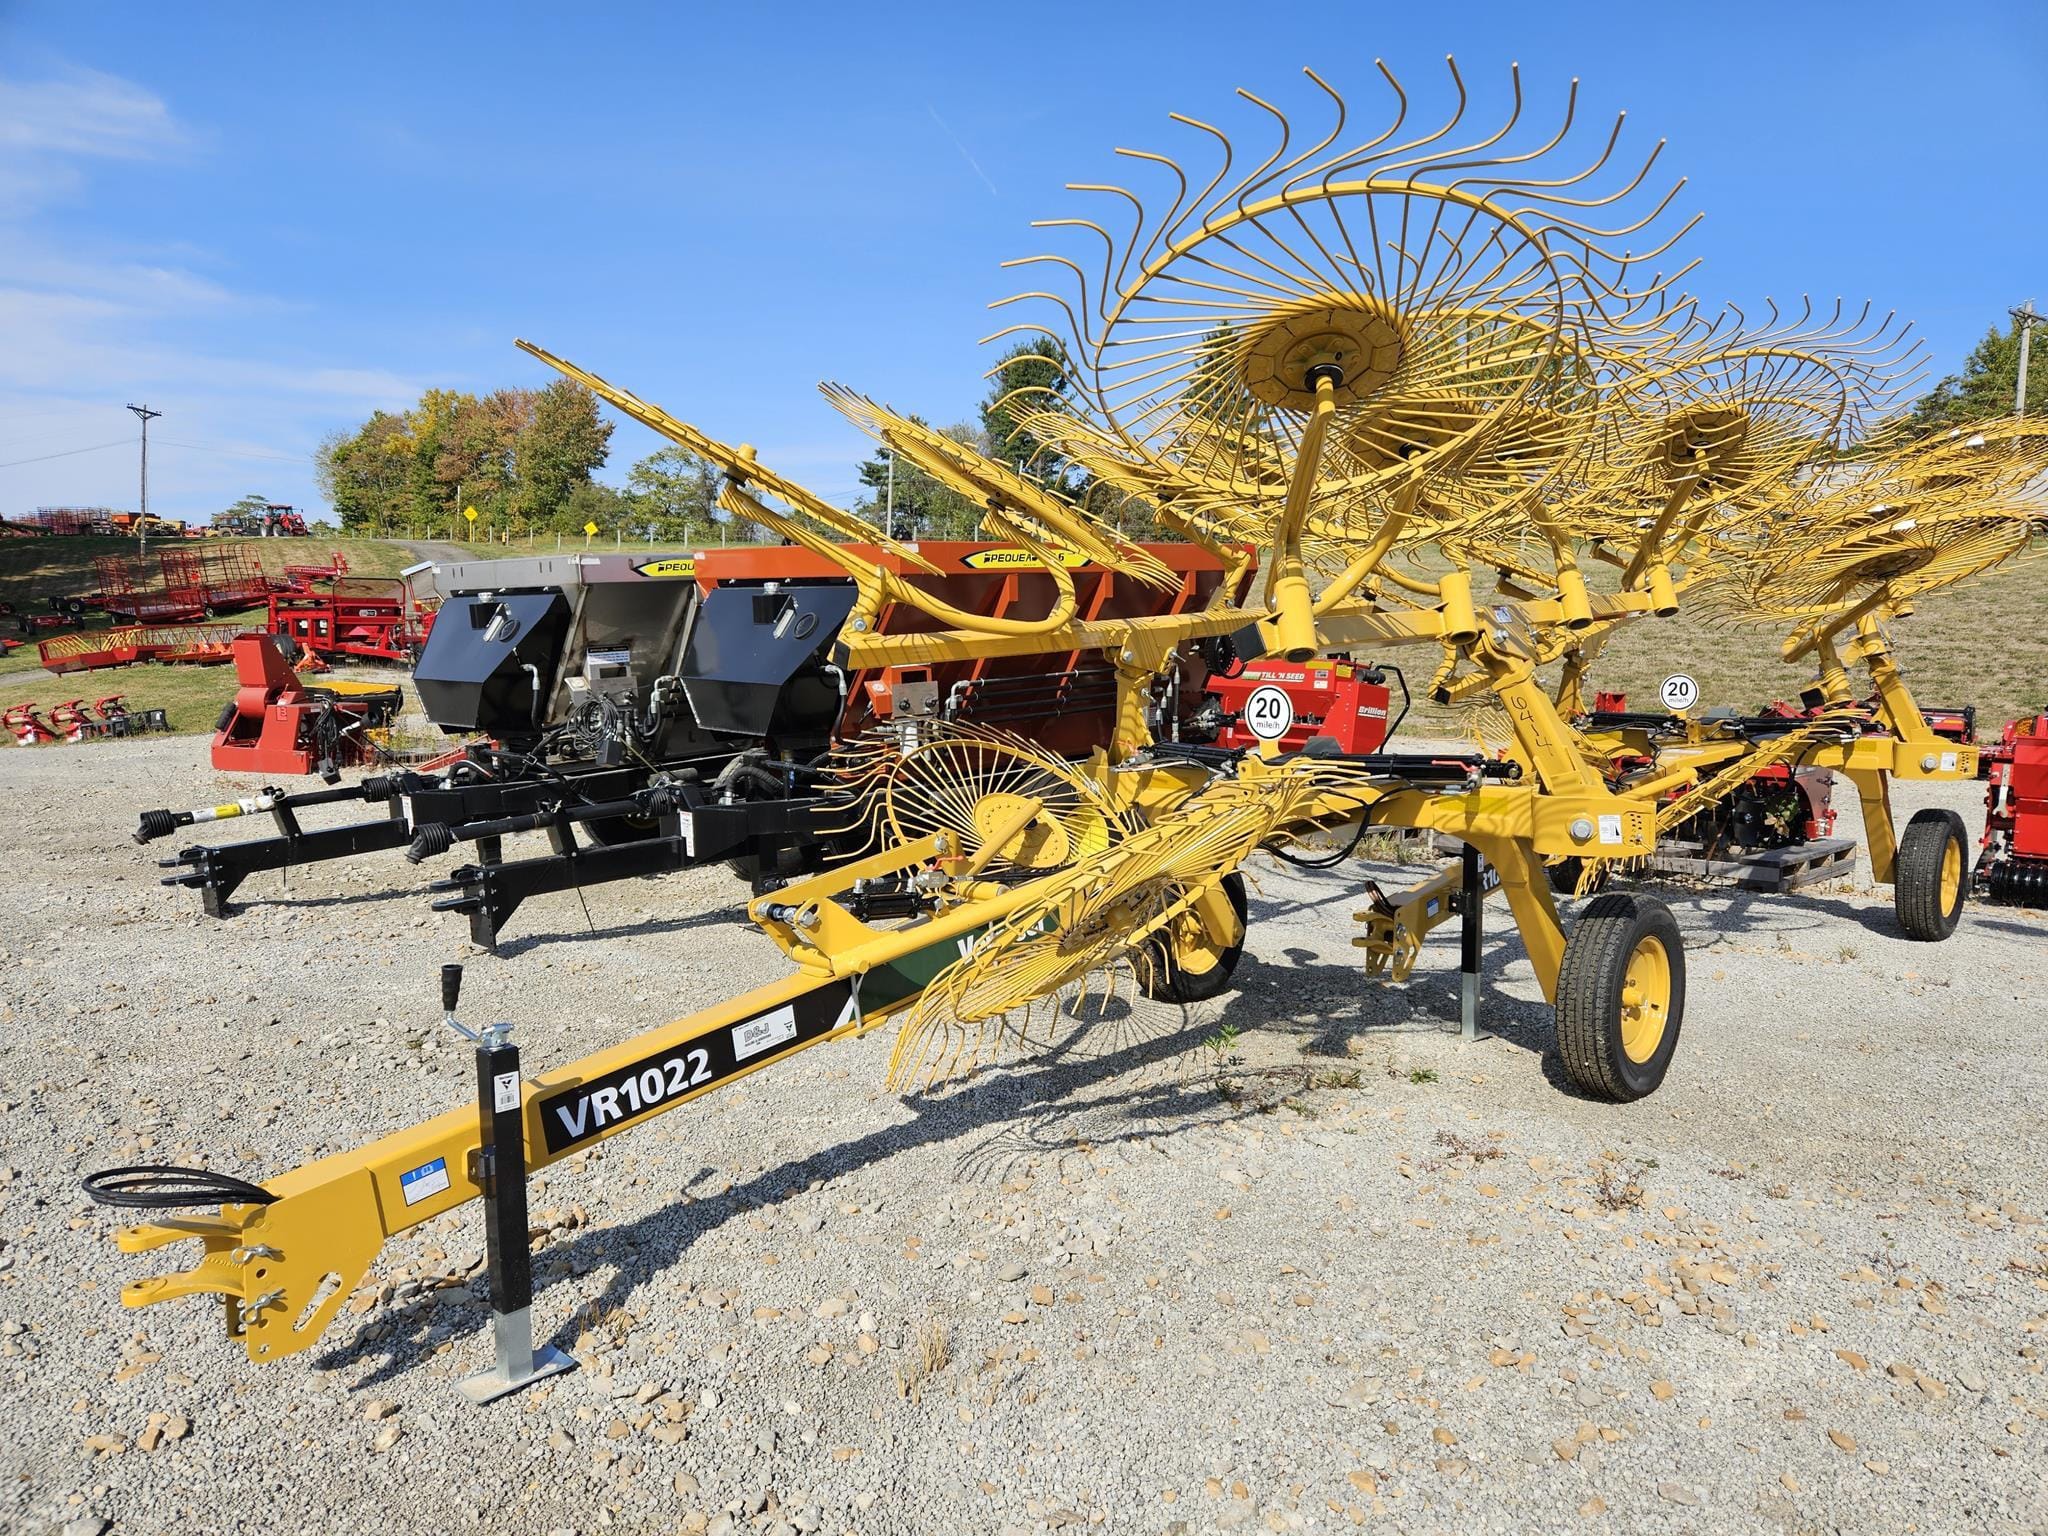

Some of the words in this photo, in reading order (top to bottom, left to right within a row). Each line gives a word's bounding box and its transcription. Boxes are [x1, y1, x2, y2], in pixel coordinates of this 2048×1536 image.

[990, 553, 1032, 562] PEQUEA
[1261, 671, 1277, 679] TILL
[1285, 672, 1305, 680] SEED
[1667, 682, 1689, 696] 20
[1255, 697, 1281, 719] 20
[1358, 706, 1387, 716] Brillion
[1256, 721, 1280, 730] mile/h
[555, 1048, 712, 1138] VR1022
